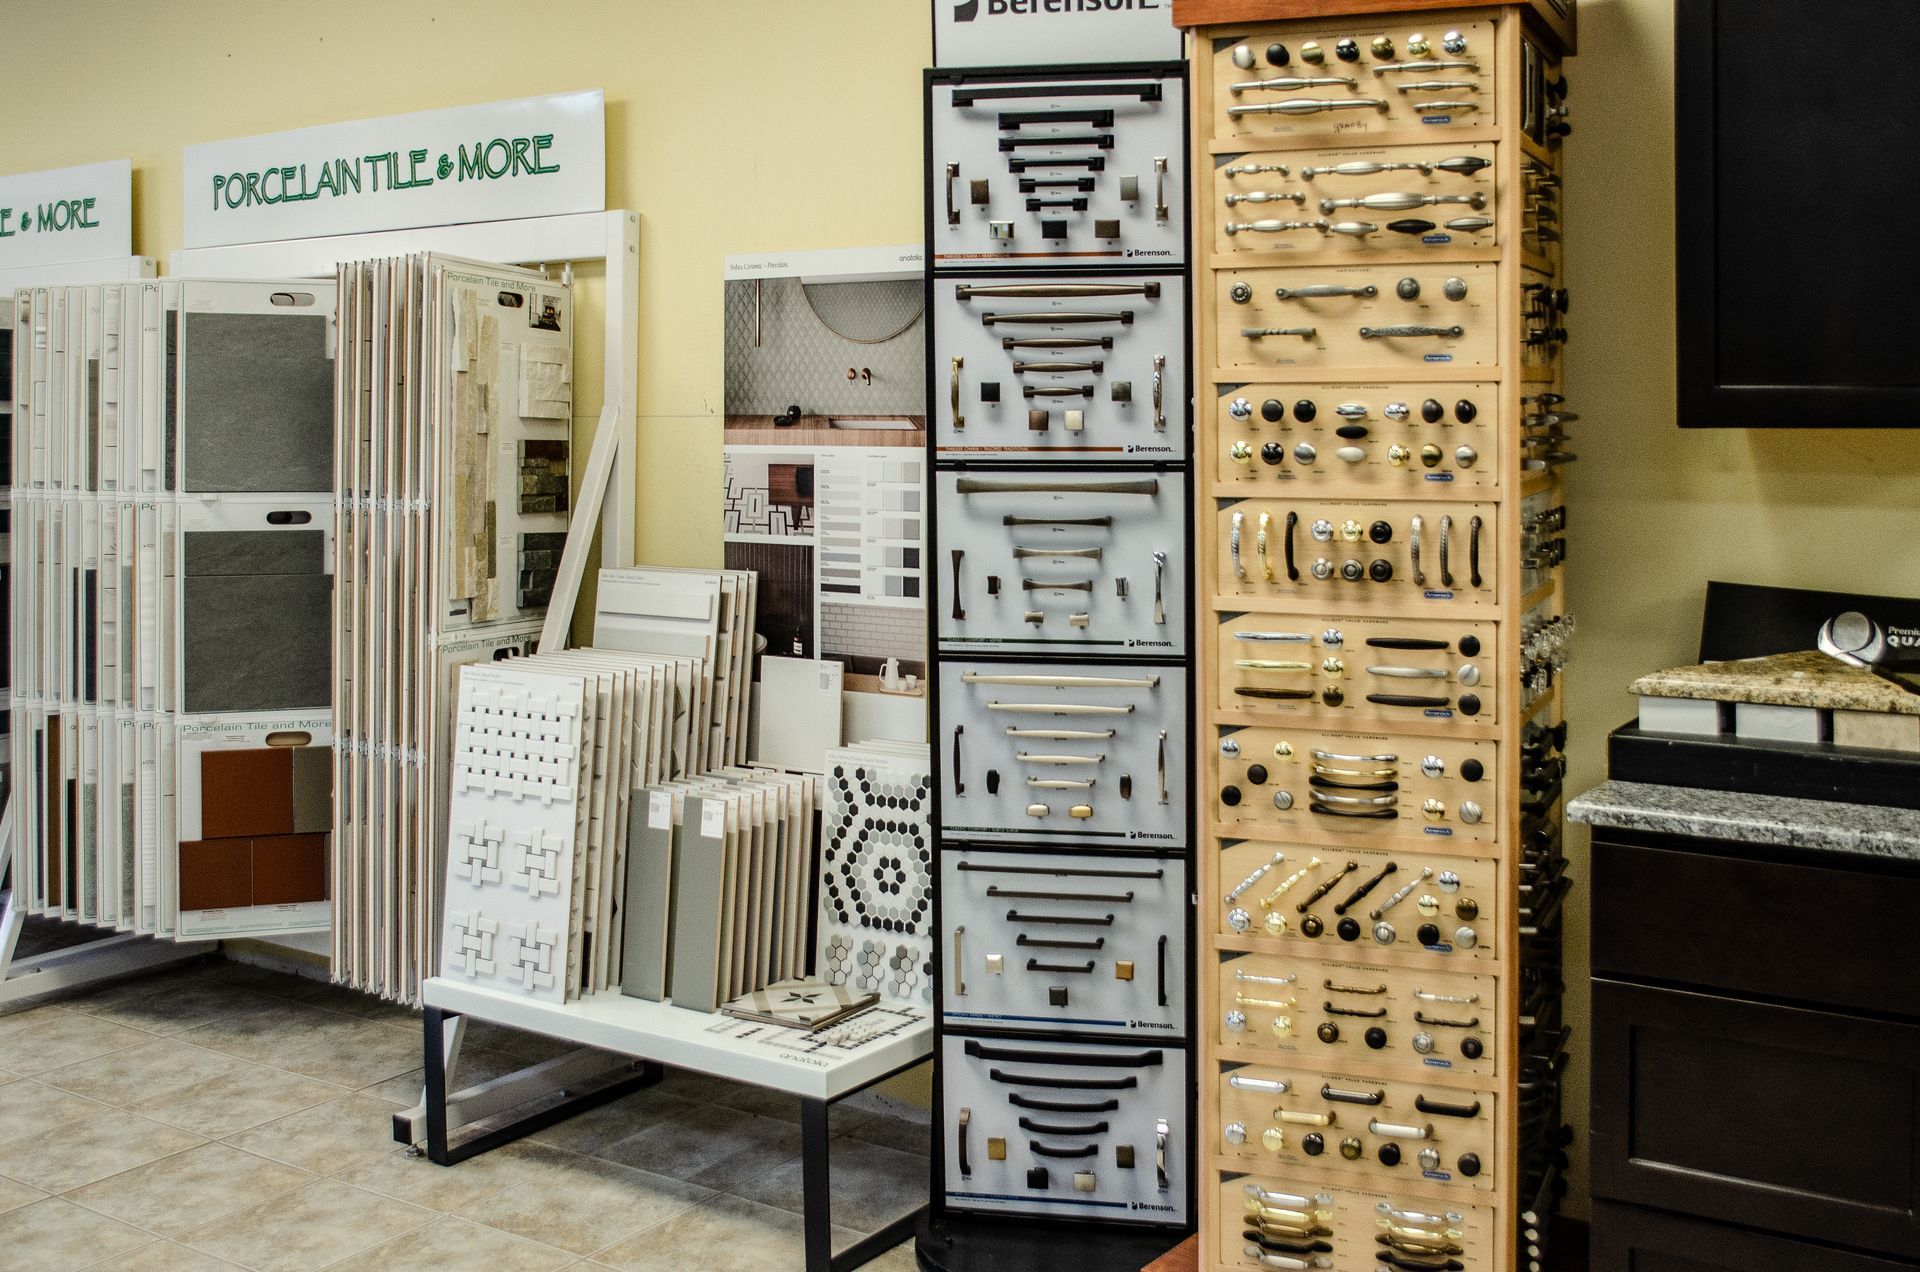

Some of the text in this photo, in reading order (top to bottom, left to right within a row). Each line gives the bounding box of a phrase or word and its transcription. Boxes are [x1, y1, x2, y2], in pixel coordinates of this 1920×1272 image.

[214, 134, 560, 211] PORCELAIN TILE & MORE
[20, 211, 32, 232] &
[37, 197, 100, 233] MORE
[448, 272, 536, 292] Porcelain Tile and More
[1888, 626, 1920, 636] Premiu
[442, 635, 531, 654] Porcelain Tile and More
[183, 720, 332, 732] Porcelain Tile and More
[1138, 1020, 1175, 1029] Berenson
[1139, 1202, 1175, 1211] Berenson
